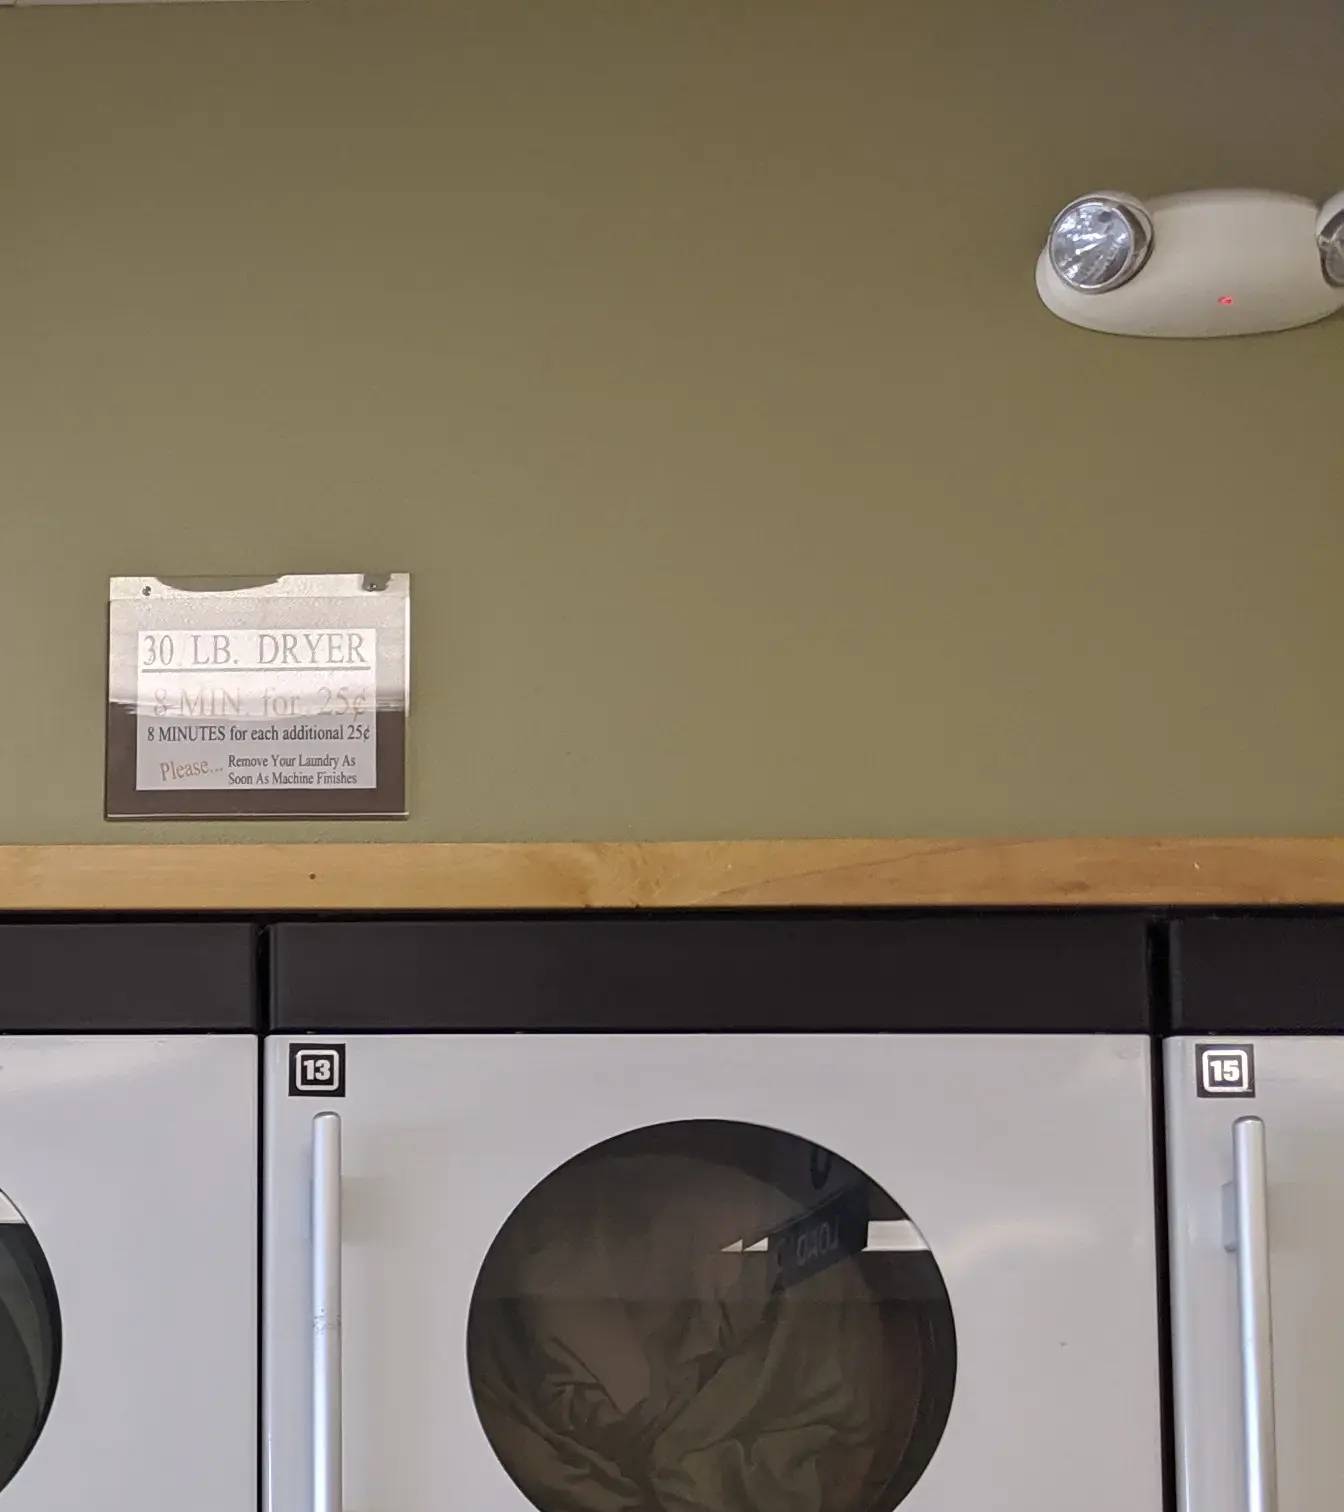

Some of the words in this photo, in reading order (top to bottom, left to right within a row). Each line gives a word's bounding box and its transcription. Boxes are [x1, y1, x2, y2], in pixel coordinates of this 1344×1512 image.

[143, 634, 174, 666] 30
[191, 634, 239, 665] LB.
[258, 633, 367, 664] DRYER
[262, 686, 299, 716] for
[317, 686, 366, 721] 25¢
[147, 727, 155, 742] 8
[158, 726, 226, 741] MINUTES
[230, 725, 248, 741] for
[250, 725, 278, 741] each
[282, 724, 344, 740] additional
[347, 724, 370, 742] 25¢
[228, 754, 268, 768] Remove
[271, 754, 296, 767] Your
[298, 754, 339, 770] Laundry
[342, 754, 356, 767] As
[228, 772, 253, 785] Soon
[256, 772, 270, 785] As
[272, 771, 314, 785] Machine
[316, 771, 357, 784] Finishes
[303, 1060, 331, 1080] 13
[1210, 1060, 1240, 1082] 15
